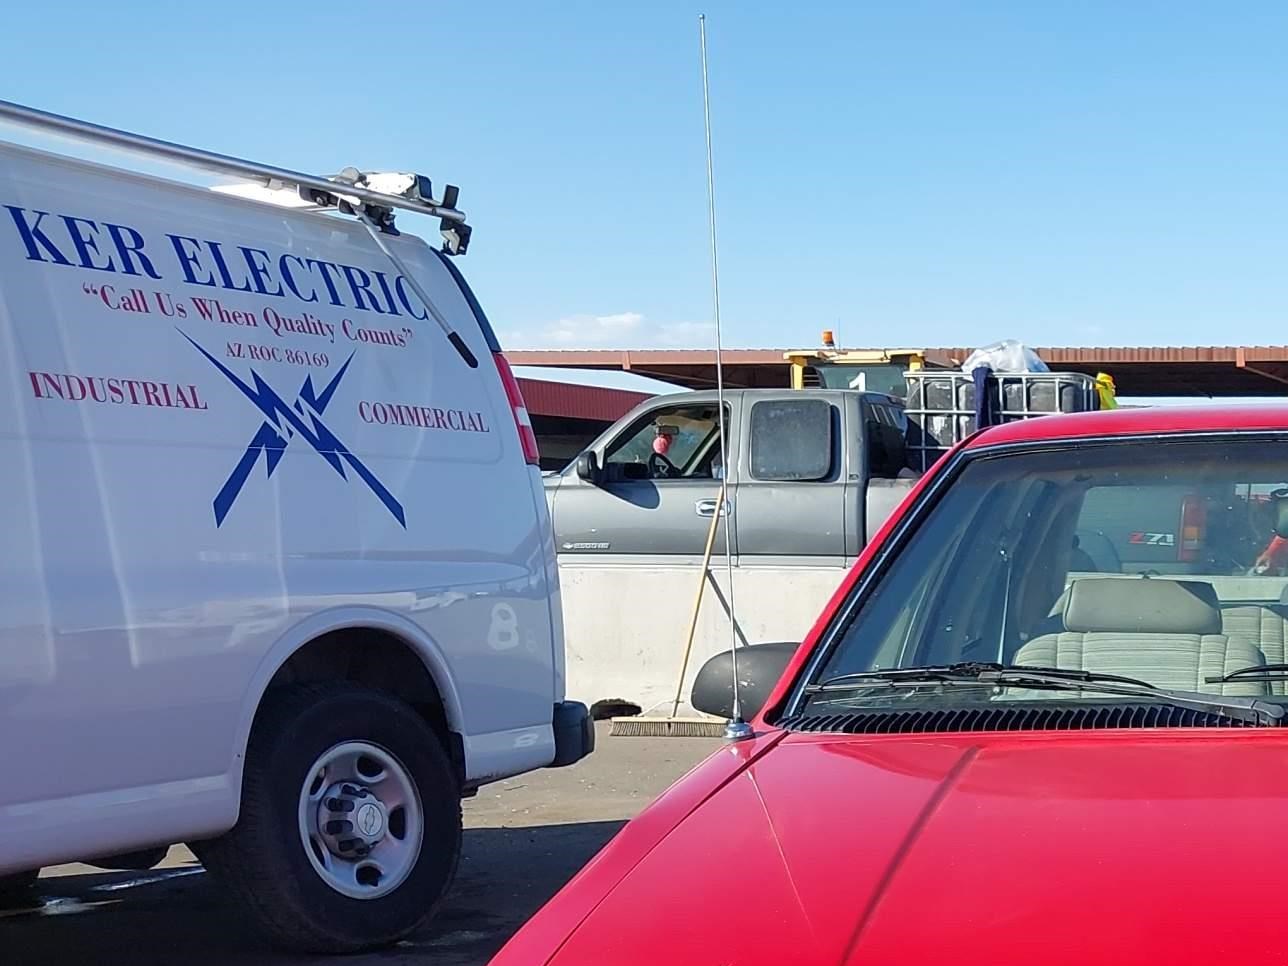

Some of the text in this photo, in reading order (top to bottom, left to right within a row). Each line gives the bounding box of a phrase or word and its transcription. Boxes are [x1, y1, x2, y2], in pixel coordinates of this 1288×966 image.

[2, 204, 429, 321] KER ELECTRIC
[153, 291, 188, 318] Us
[190, 296, 258, 327] When
[263, 306, 335, 344] Quality
[226, 341, 330, 368] AZ ROC 86169
[28, 372, 208, 410] INDUSTRIAL
[359, 400, 490, 433] COMMERCIAL
